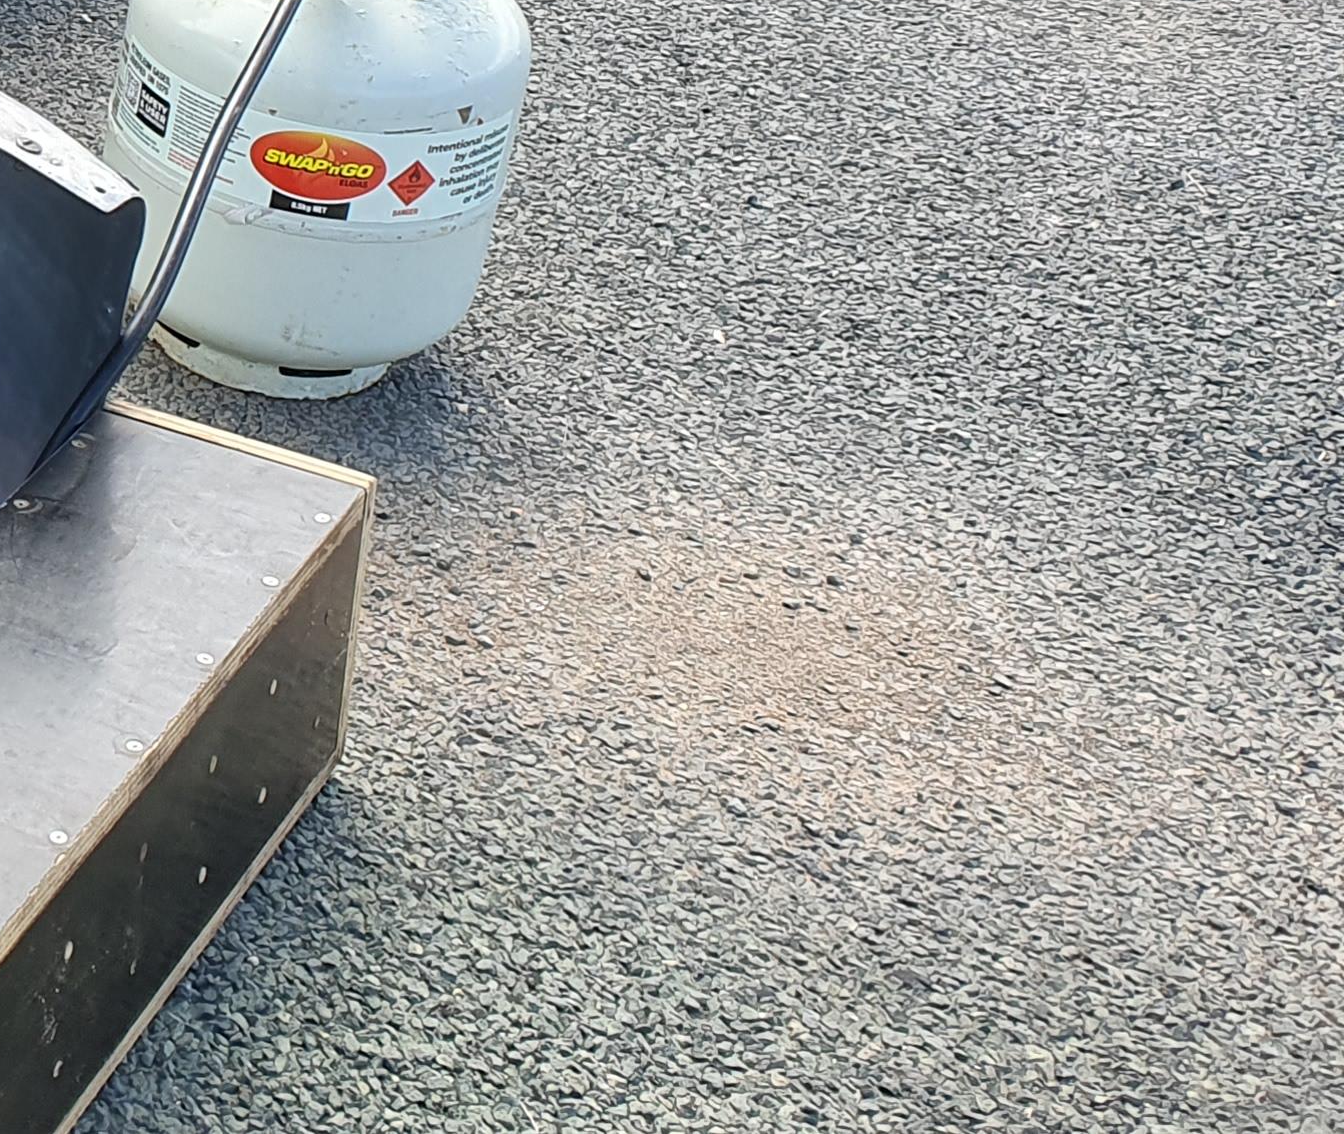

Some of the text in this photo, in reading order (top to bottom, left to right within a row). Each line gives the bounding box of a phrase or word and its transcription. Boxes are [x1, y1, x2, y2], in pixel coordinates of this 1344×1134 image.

[427, 135, 483, 154] Intentional
[454, 152, 467, 162] by
[438, 168, 484, 187] inhalation
[450, 183, 476, 197] cause
